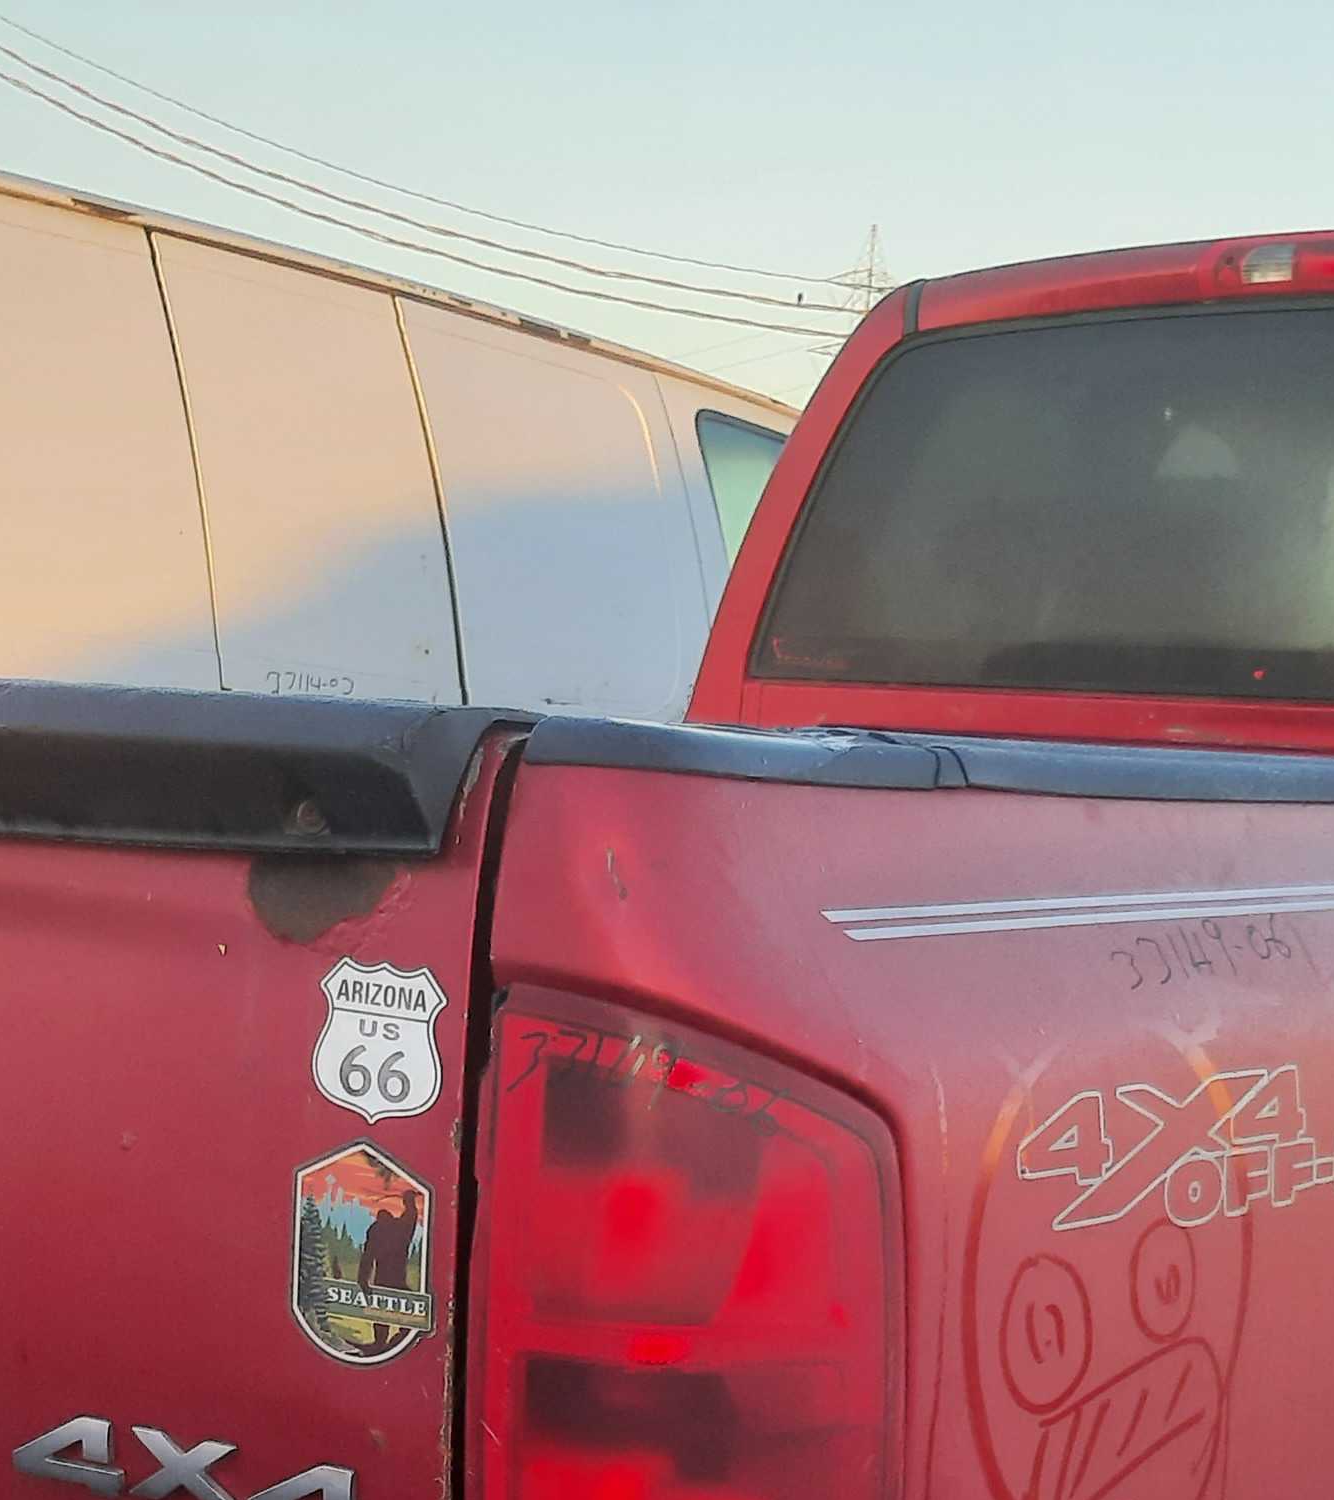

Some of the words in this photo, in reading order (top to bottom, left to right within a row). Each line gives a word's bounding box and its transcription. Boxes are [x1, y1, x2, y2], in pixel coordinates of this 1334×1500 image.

[336, 979, 427, 1013] ARIZONA
[358, 1018, 401, 1041] US
[338, 1044, 411, 1104] 66
[1016, 1064, 1307, 1230] 4X4
[326, 1286, 428, 1318] SEATTLE
